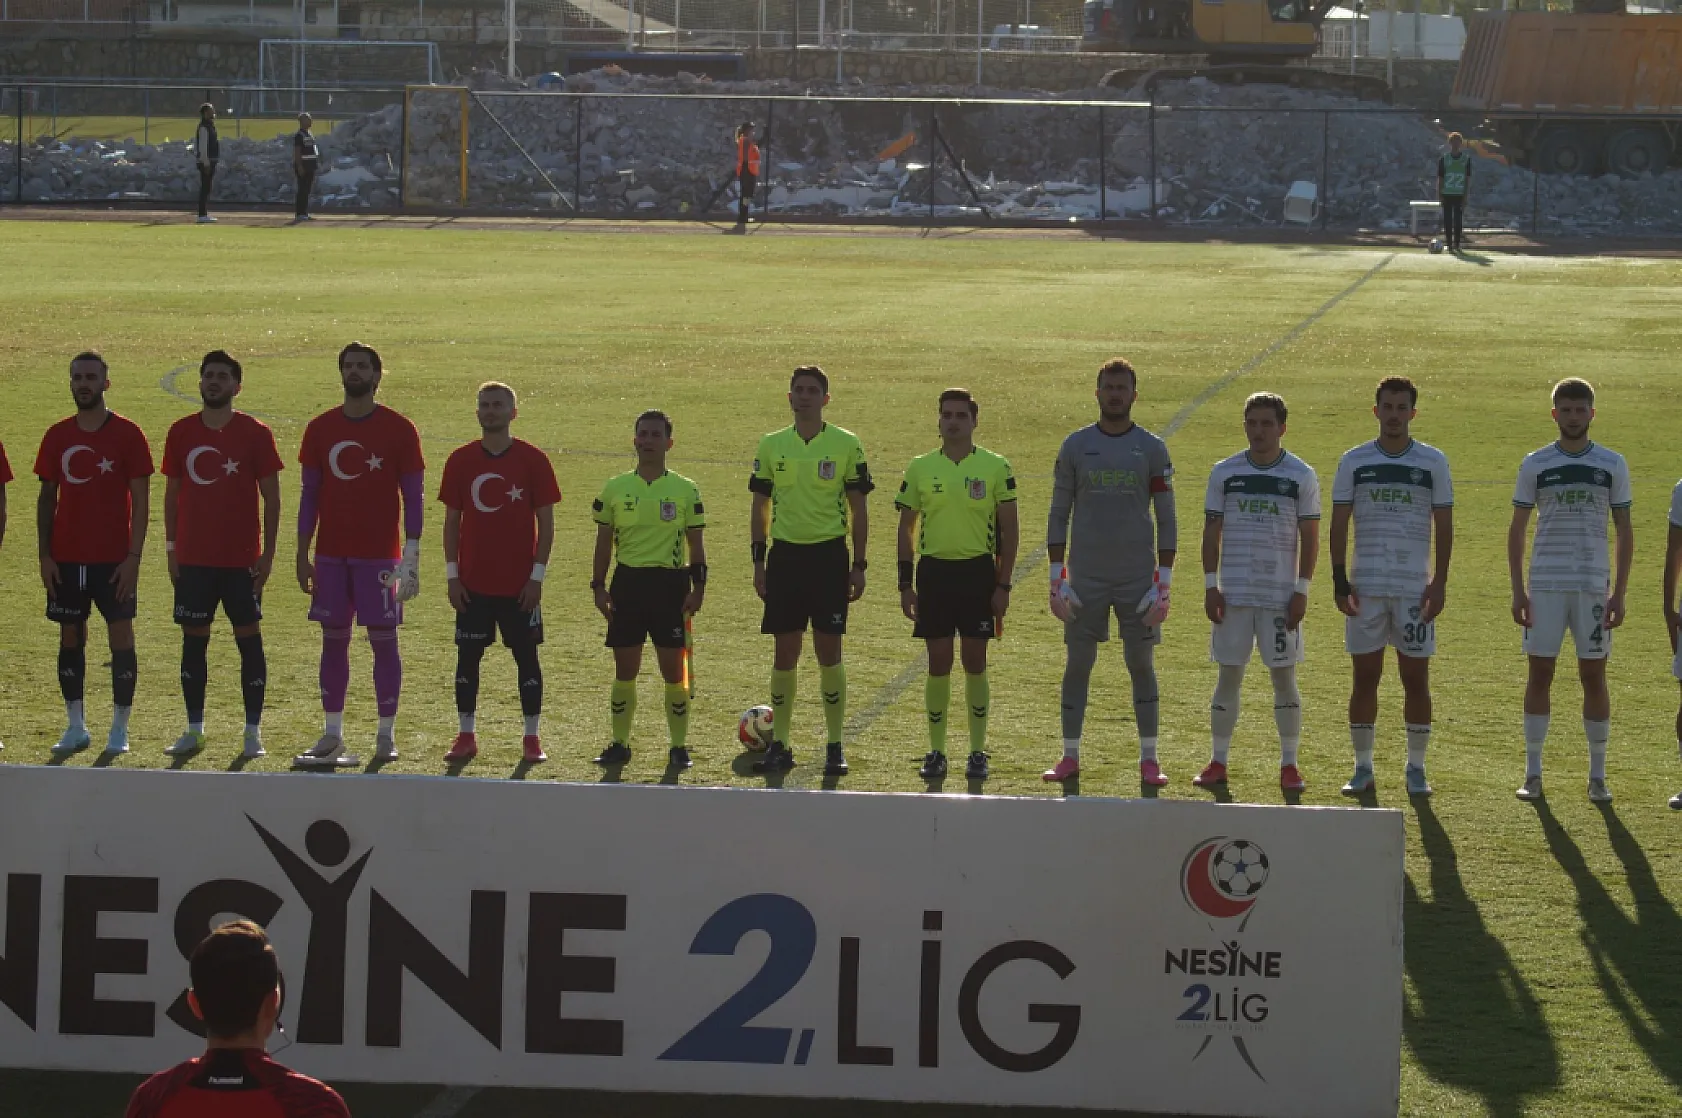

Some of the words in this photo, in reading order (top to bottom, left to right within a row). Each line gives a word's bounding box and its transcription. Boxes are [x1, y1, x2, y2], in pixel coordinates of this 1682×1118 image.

[1445, 172, 1465, 188] 22
[1088, 470, 1137, 487] VEFA
[1368, 488, 1412, 504] VEFA
[1555, 489, 1594, 505] VEFA
[1237, 499, 1280, 515] VEFA
[1403, 622, 1426, 642] 30
[1589, 623, 1602, 646] 4
[1275, 631, 1286, 652] 5
